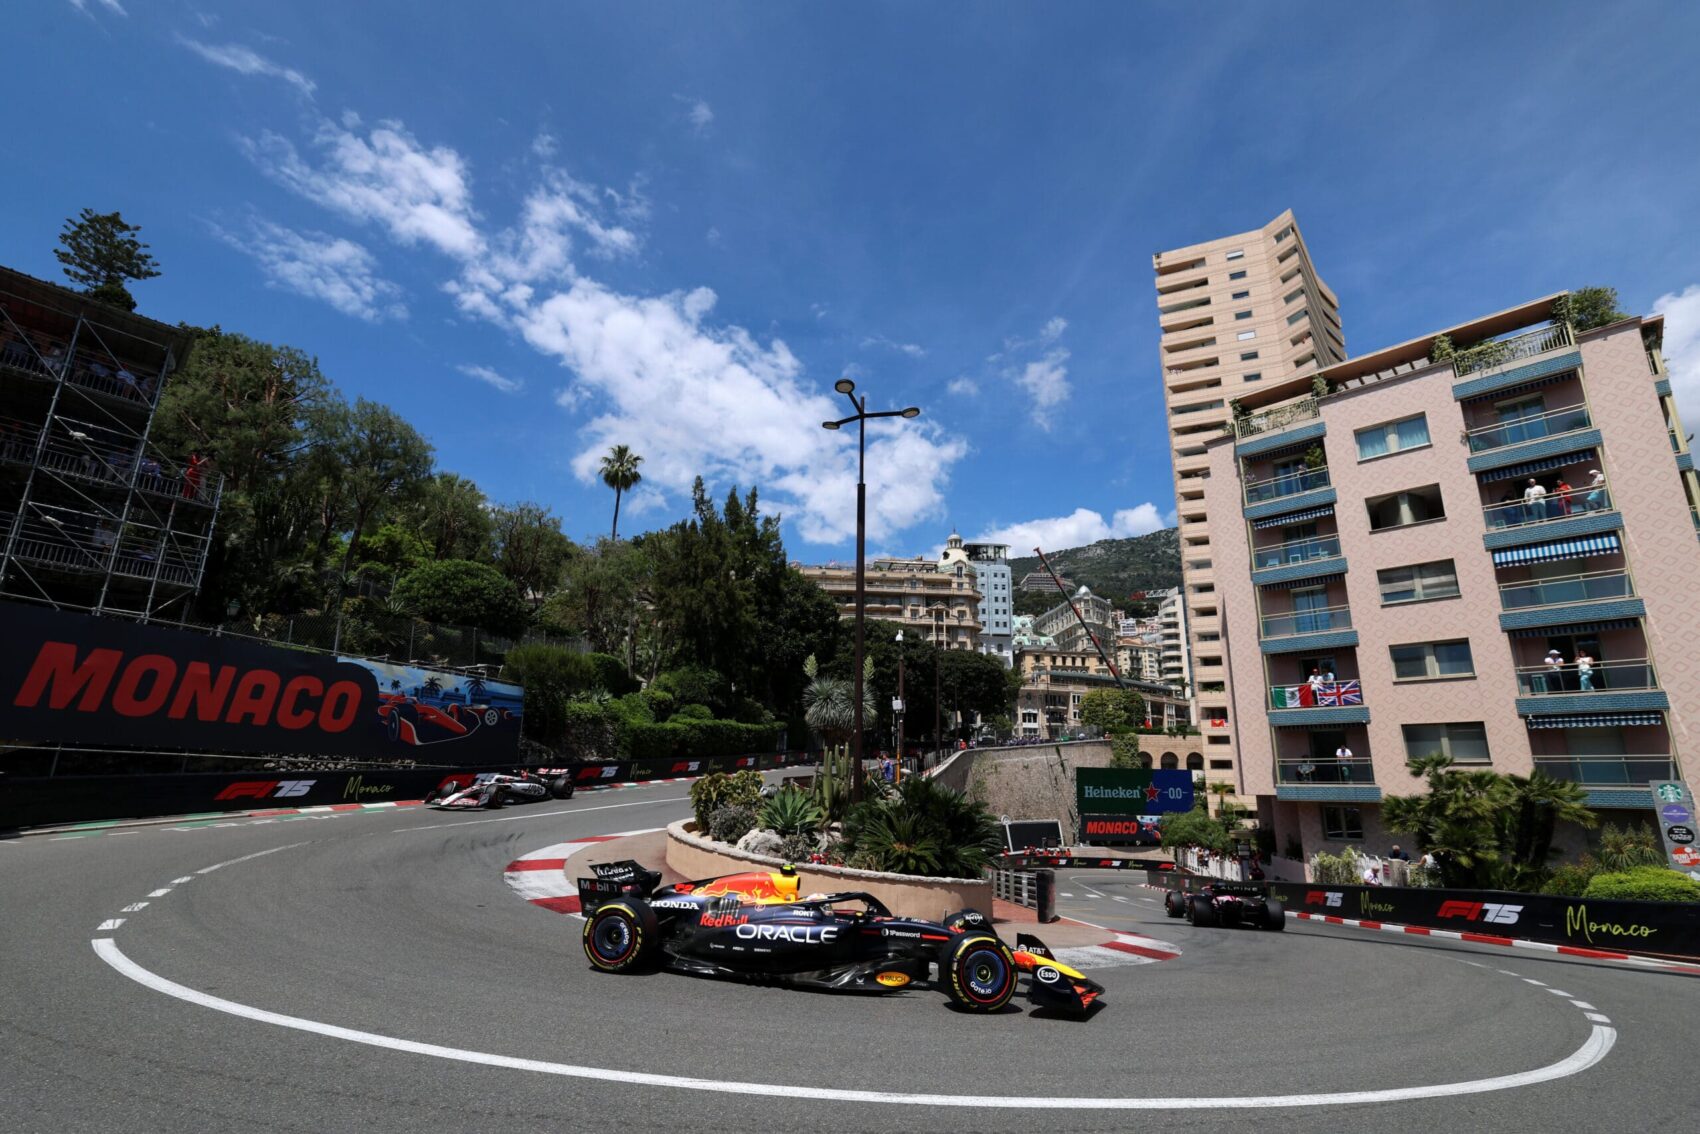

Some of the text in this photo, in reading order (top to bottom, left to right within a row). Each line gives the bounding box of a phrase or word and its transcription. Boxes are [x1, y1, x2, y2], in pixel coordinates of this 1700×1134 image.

[14, 641, 362, 732] MONACO
[343, 775, 394, 800] Monaco
[1084, 786, 1141, 799] Heineken
[1086, 821, 1138, 835] MONACO
[580, 880, 609, 892] Mobil
[649, 900, 700, 910] HONDA
[1360, 890, 1395, 917] Monaco
[700, 912, 749, 927] Red Bull
[1566, 904, 1658, 944] Monaco
[736, 924, 839, 945] ORACLE
[889, 929, 921, 938] 1Password
[1028, 946, 1046, 955] AT&T
[885, 975, 906, 983] RAUCH
[1040, 969, 1057, 978] Esso
[970, 981, 992, 994] Gate.io
